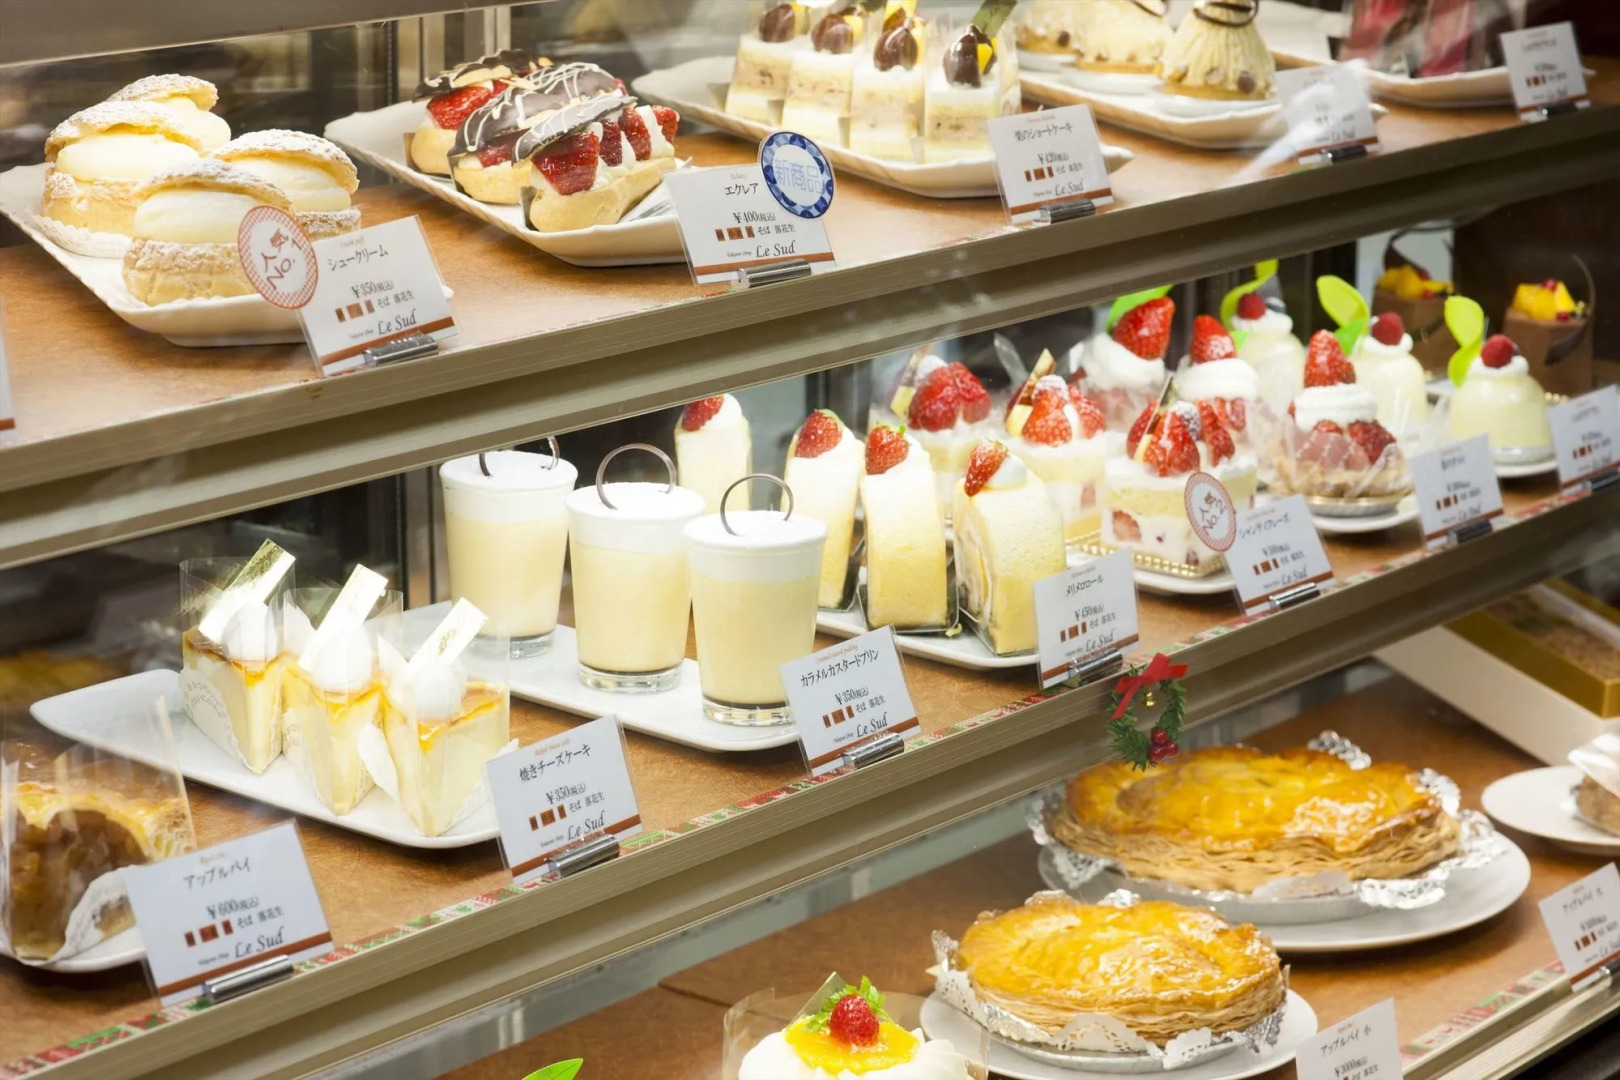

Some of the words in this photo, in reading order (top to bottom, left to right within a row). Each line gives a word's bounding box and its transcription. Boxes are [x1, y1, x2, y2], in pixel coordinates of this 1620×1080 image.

[724, 182, 759, 196] エクレア
[774, 158, 826, 194] 新商品
[328, 244, 389, 271] シュークリーム
[755, 245, 770, 258] Le
[773, 240, 796, 257] Sud
[378, 321, 392, 335] Le
[395, 308, 417, 331] Sud
[800, 648, 881, 688] カラメルカスタードプリン
[857, 724, 868, 738] Le
[870, 711, 888, 732] Sud
[519, 743, 592, 783] 焼きチーズケーキ
[567, 825, 581, 841] Le
[584, 810, 606, 834] Sud
[183, 857, 251, 891] アップルパイ
[234, 941, 252, 959] Le
[256, 926, 285, 953] Sud
